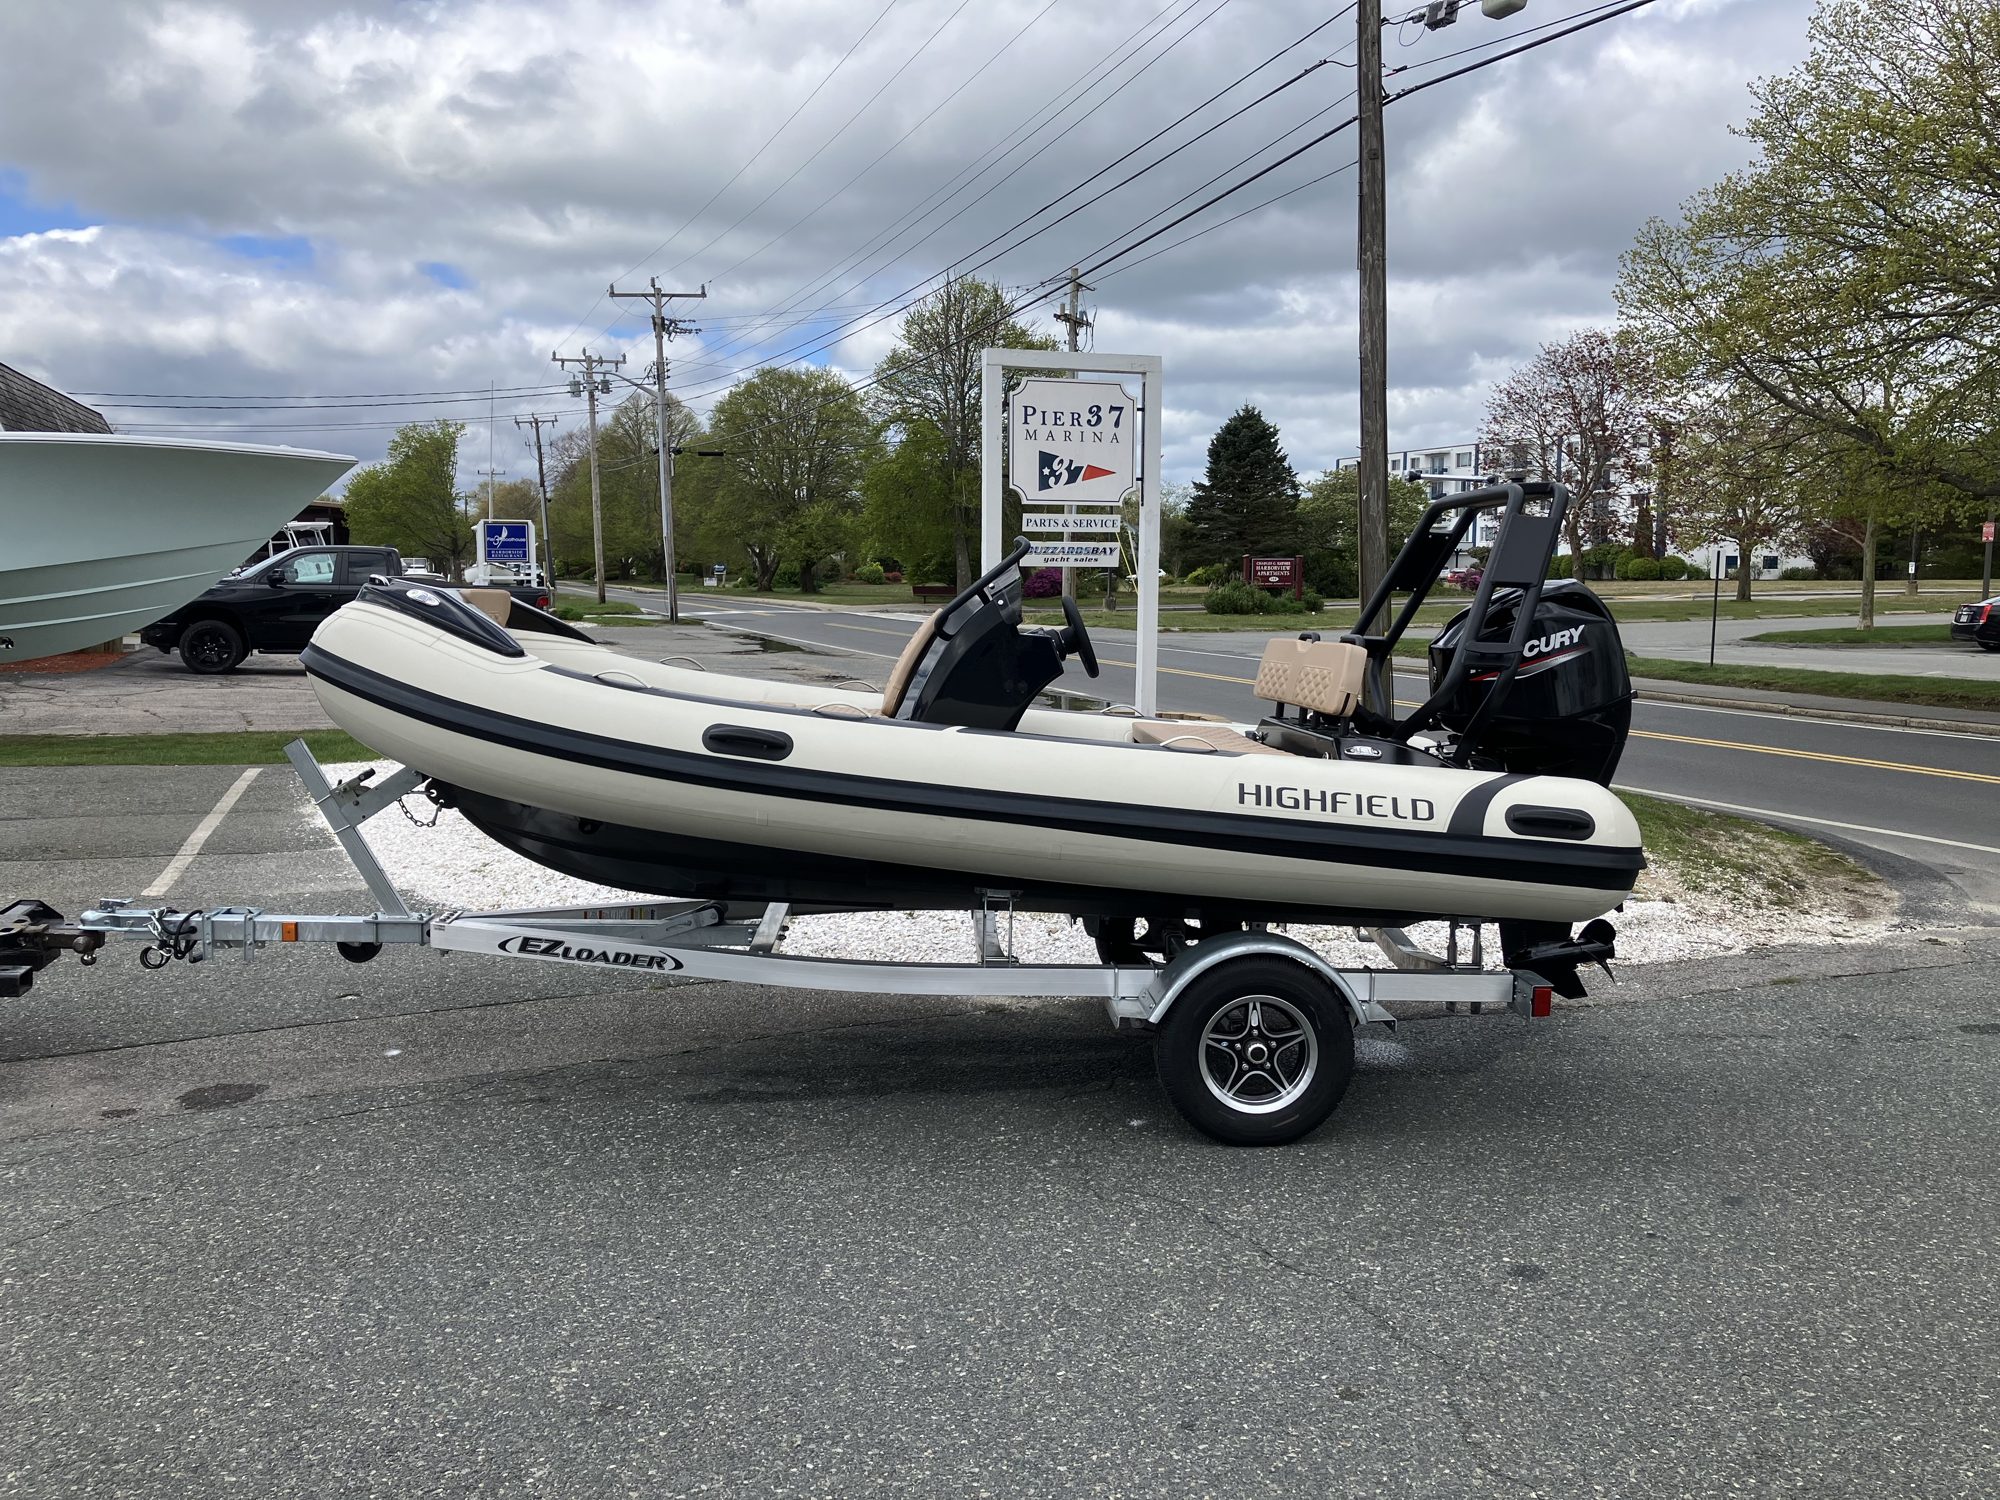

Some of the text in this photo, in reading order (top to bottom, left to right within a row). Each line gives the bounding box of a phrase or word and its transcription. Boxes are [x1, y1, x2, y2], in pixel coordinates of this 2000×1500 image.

[1024, 429, 1120, 444] MARINA
[1026, 518, 1118, 528] PARTS & SERVICE
[1238, 783, 1435, 821] HIGHFIELD
